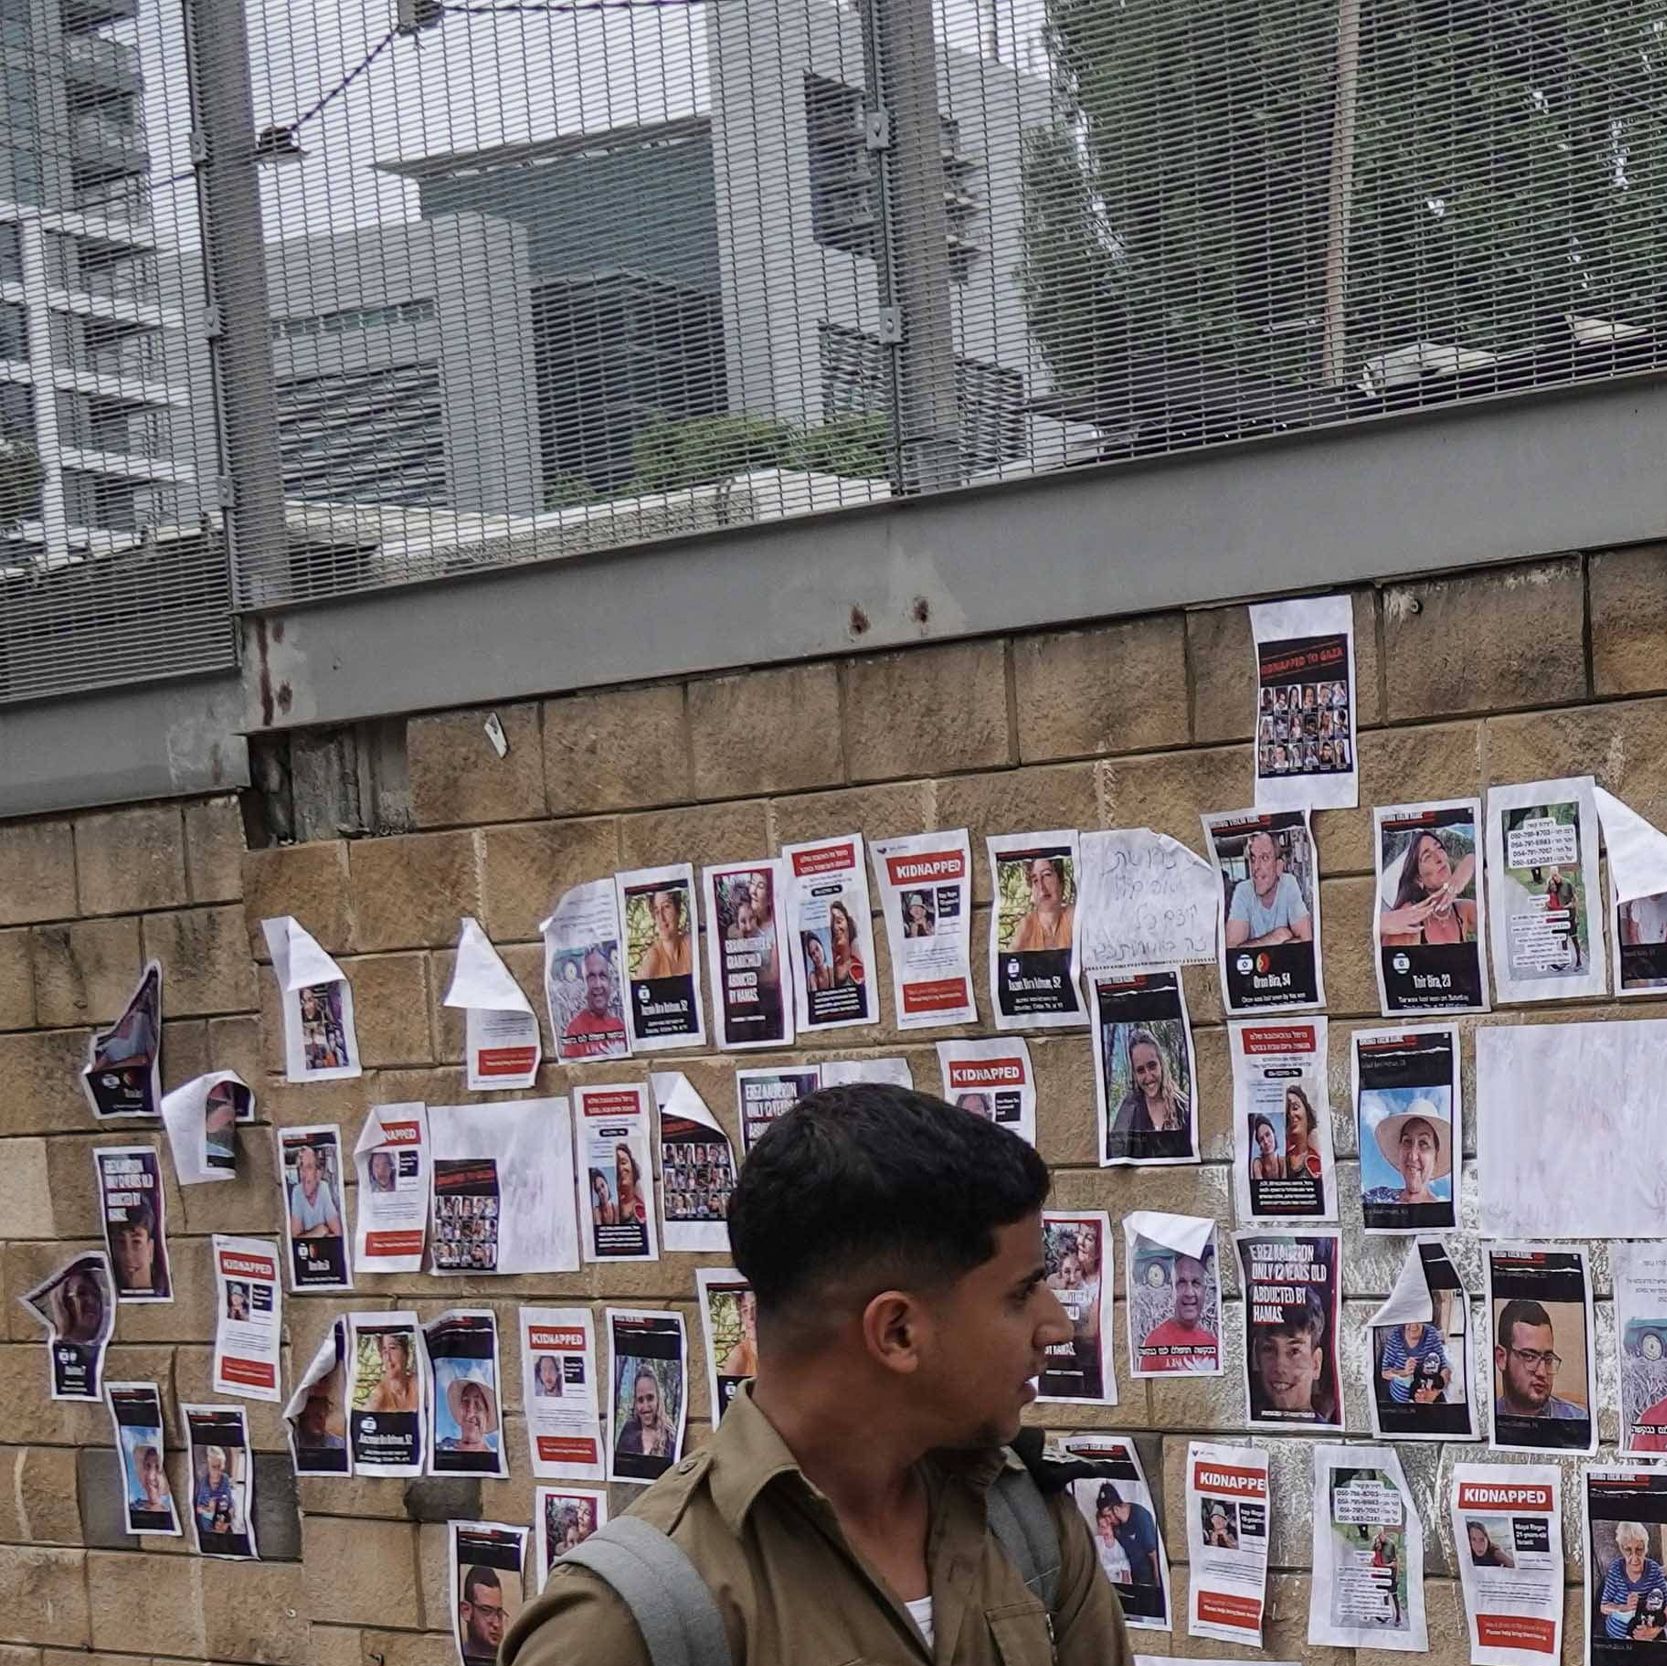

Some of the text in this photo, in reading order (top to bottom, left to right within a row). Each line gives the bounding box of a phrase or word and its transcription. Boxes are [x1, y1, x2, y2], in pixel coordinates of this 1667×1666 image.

[896, 859, 963, 883] KIDNAPPED
[952, 1066, 1019, 1081] KIDNAPPED
[1252, 1262, 1327, 1282] ONLY 12 YEARS OLD
[1251, 1287, 1307, 1304] ABDUCTED BY
[1253, 1305, 1284, 1322] HAMAS.
[1464, 1488, 1546, 1503] KIDNAPPED
